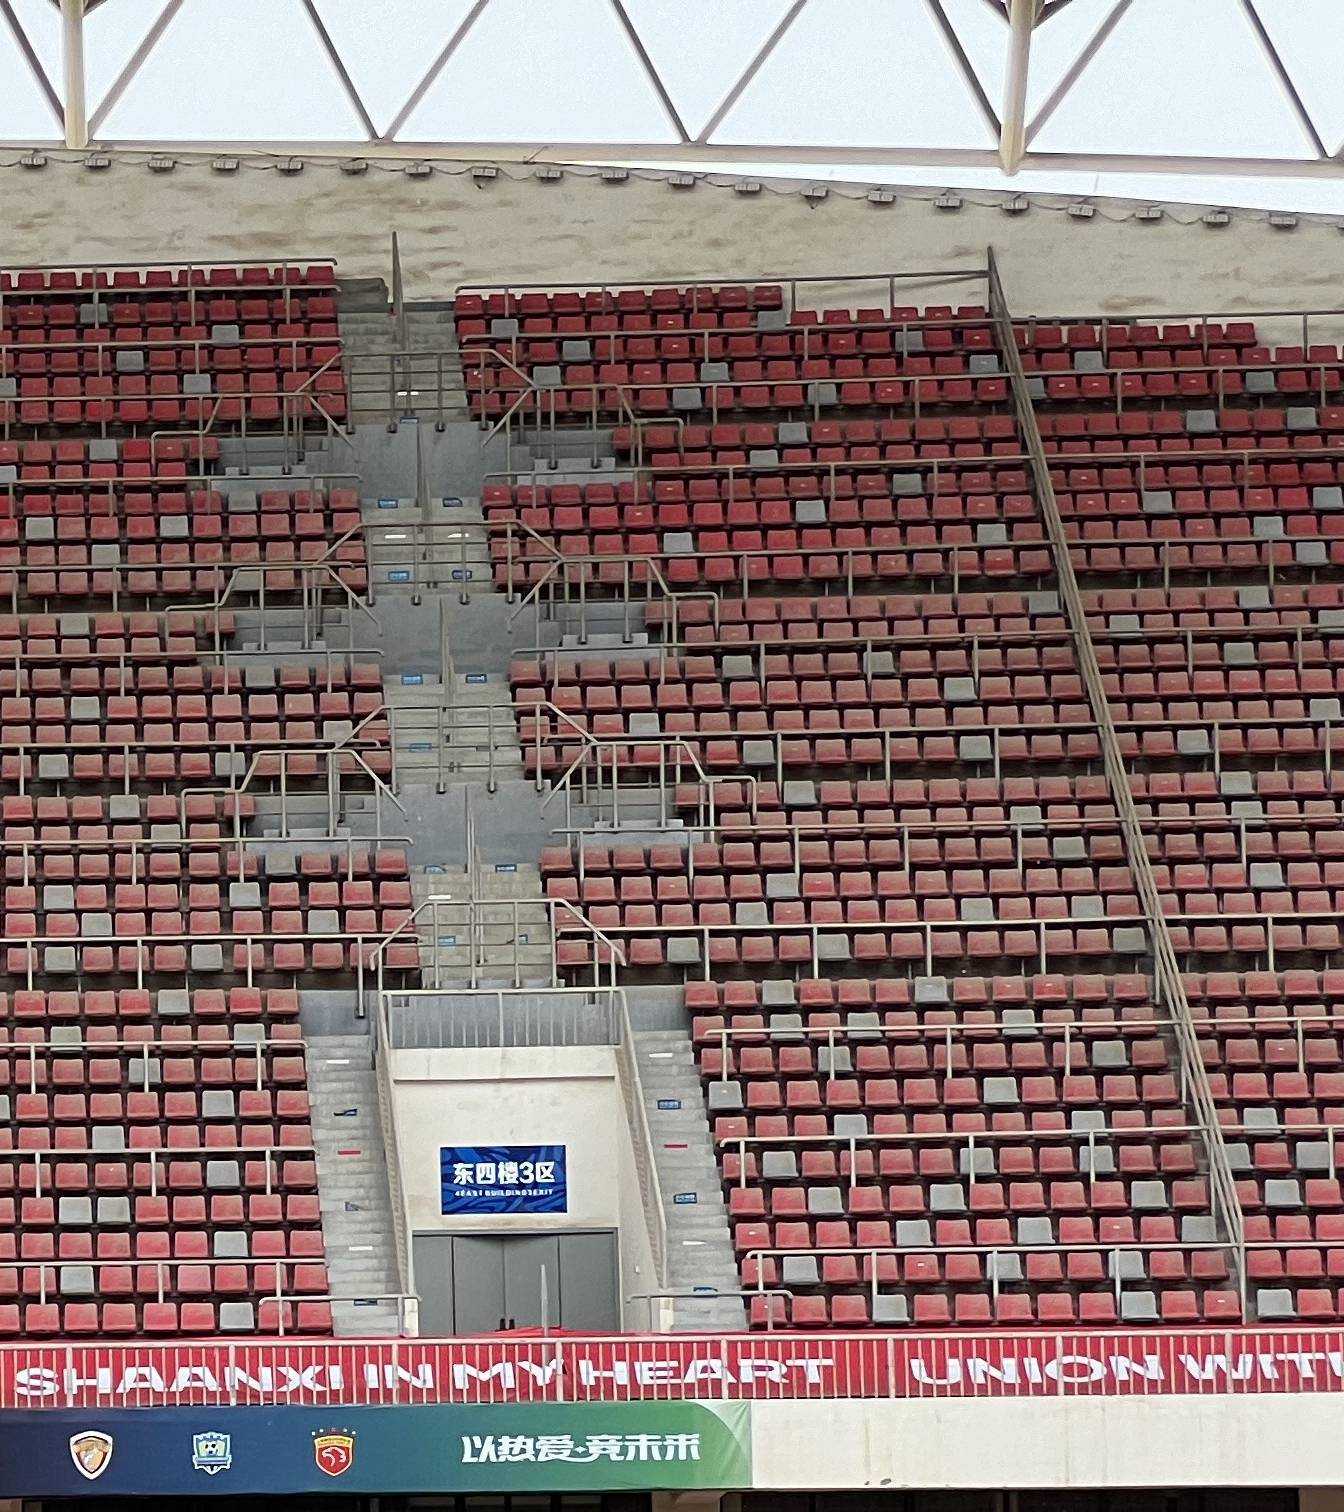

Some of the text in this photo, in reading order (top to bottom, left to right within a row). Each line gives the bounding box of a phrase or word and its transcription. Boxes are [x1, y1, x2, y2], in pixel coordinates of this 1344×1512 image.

[452, 1161, 556, 1185] 东四楼3区
[15, 1364, 344, 1396] SHAANXI
[364, 1363, 434, 1390] IN
[453, 1359, 565, 1389] MY
[578, 1358, 834, 1385] HEART
[910, 1354, 1165, 1385] UNION
